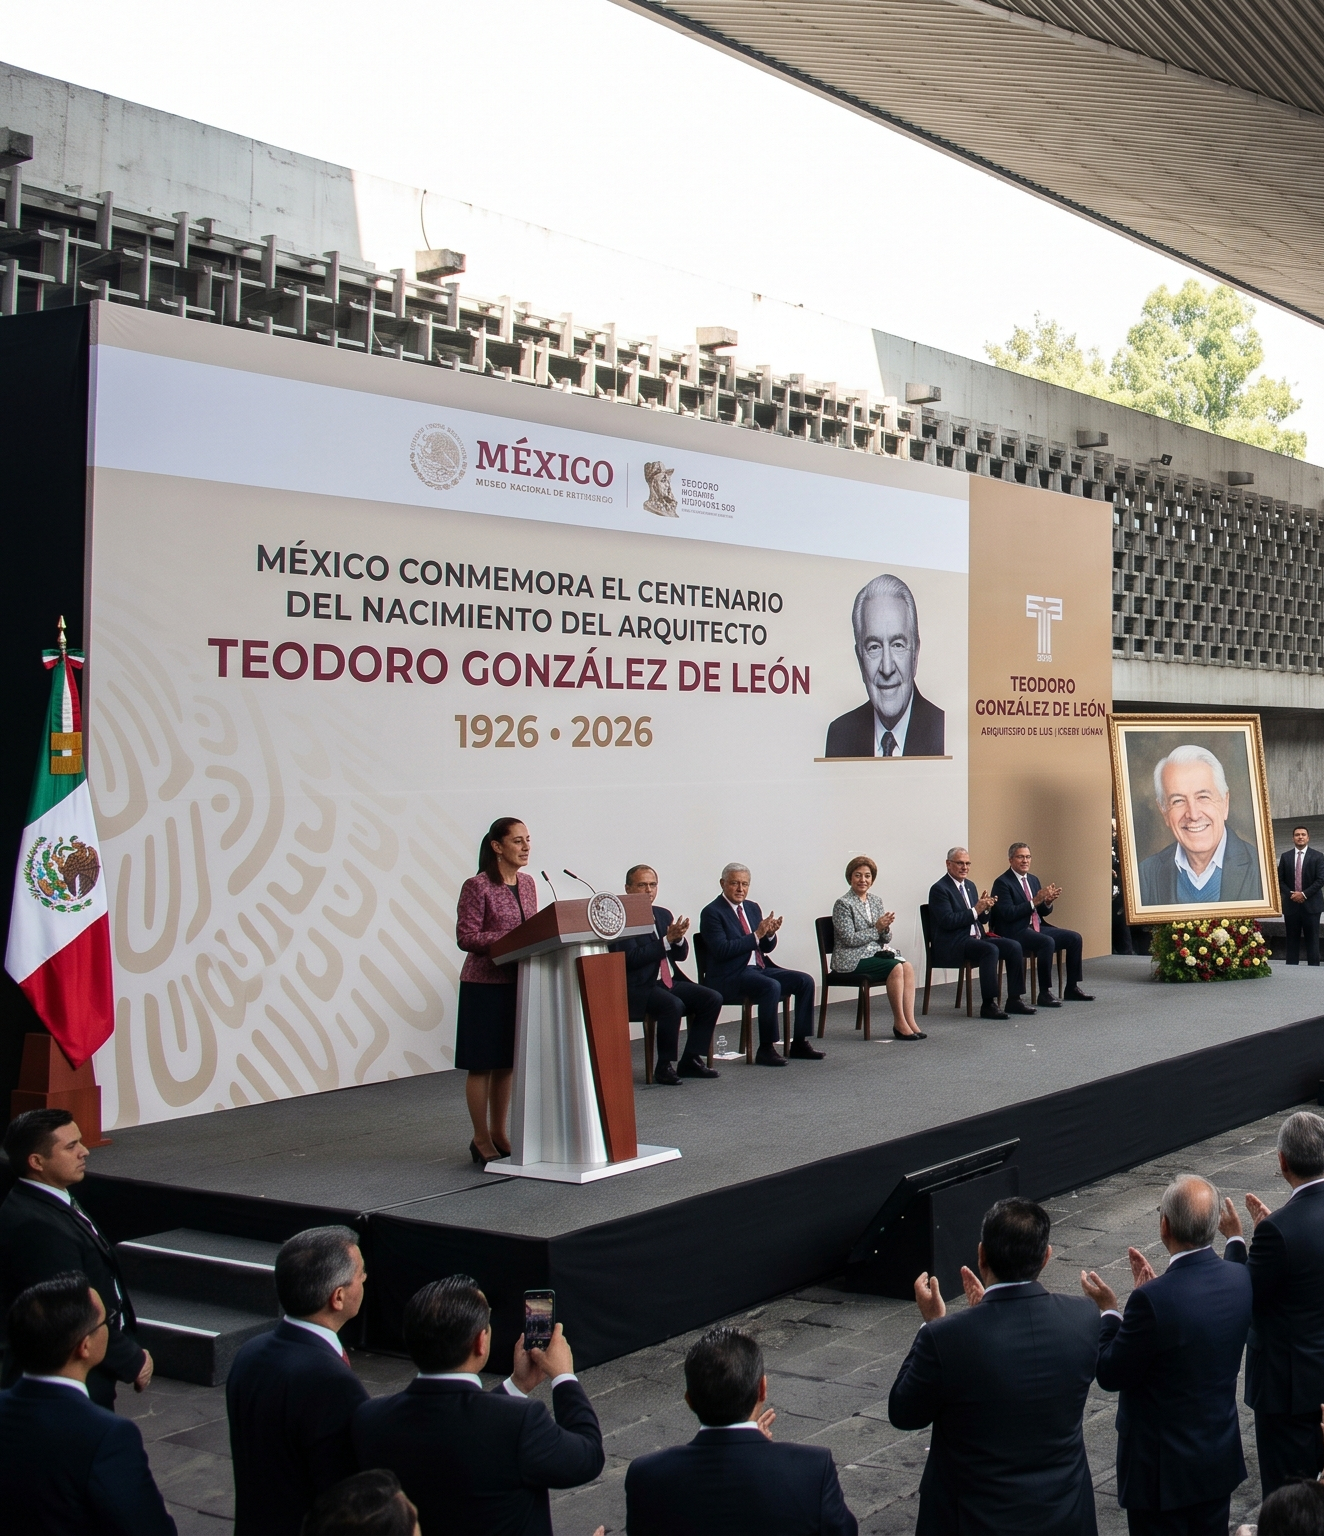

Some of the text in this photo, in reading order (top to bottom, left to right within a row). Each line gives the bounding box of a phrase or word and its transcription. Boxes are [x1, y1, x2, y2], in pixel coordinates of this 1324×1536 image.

[476, 436, 614, 488] MÉXICO
[475, 478, 507, 489] MUSEO
[553, 489, 564, 498] DE
[256, 540, 784, 614] MÉXICO CONMEMORA EL CENTENARIO
[286, 590, 768, 646] DEL NACIMIENTO DEL ARQUITECTO
[207, 637, 810, 695] TEODORO GONZÁLEZ DE LEÓN
[1010, 675, 1076, 694] TEODORO
[975, 695, 1106, 718] GONZÁLEZ DE LEÓN
[454, 714, 540, 749] 1926
[570, 715, 653, 748] 2026
